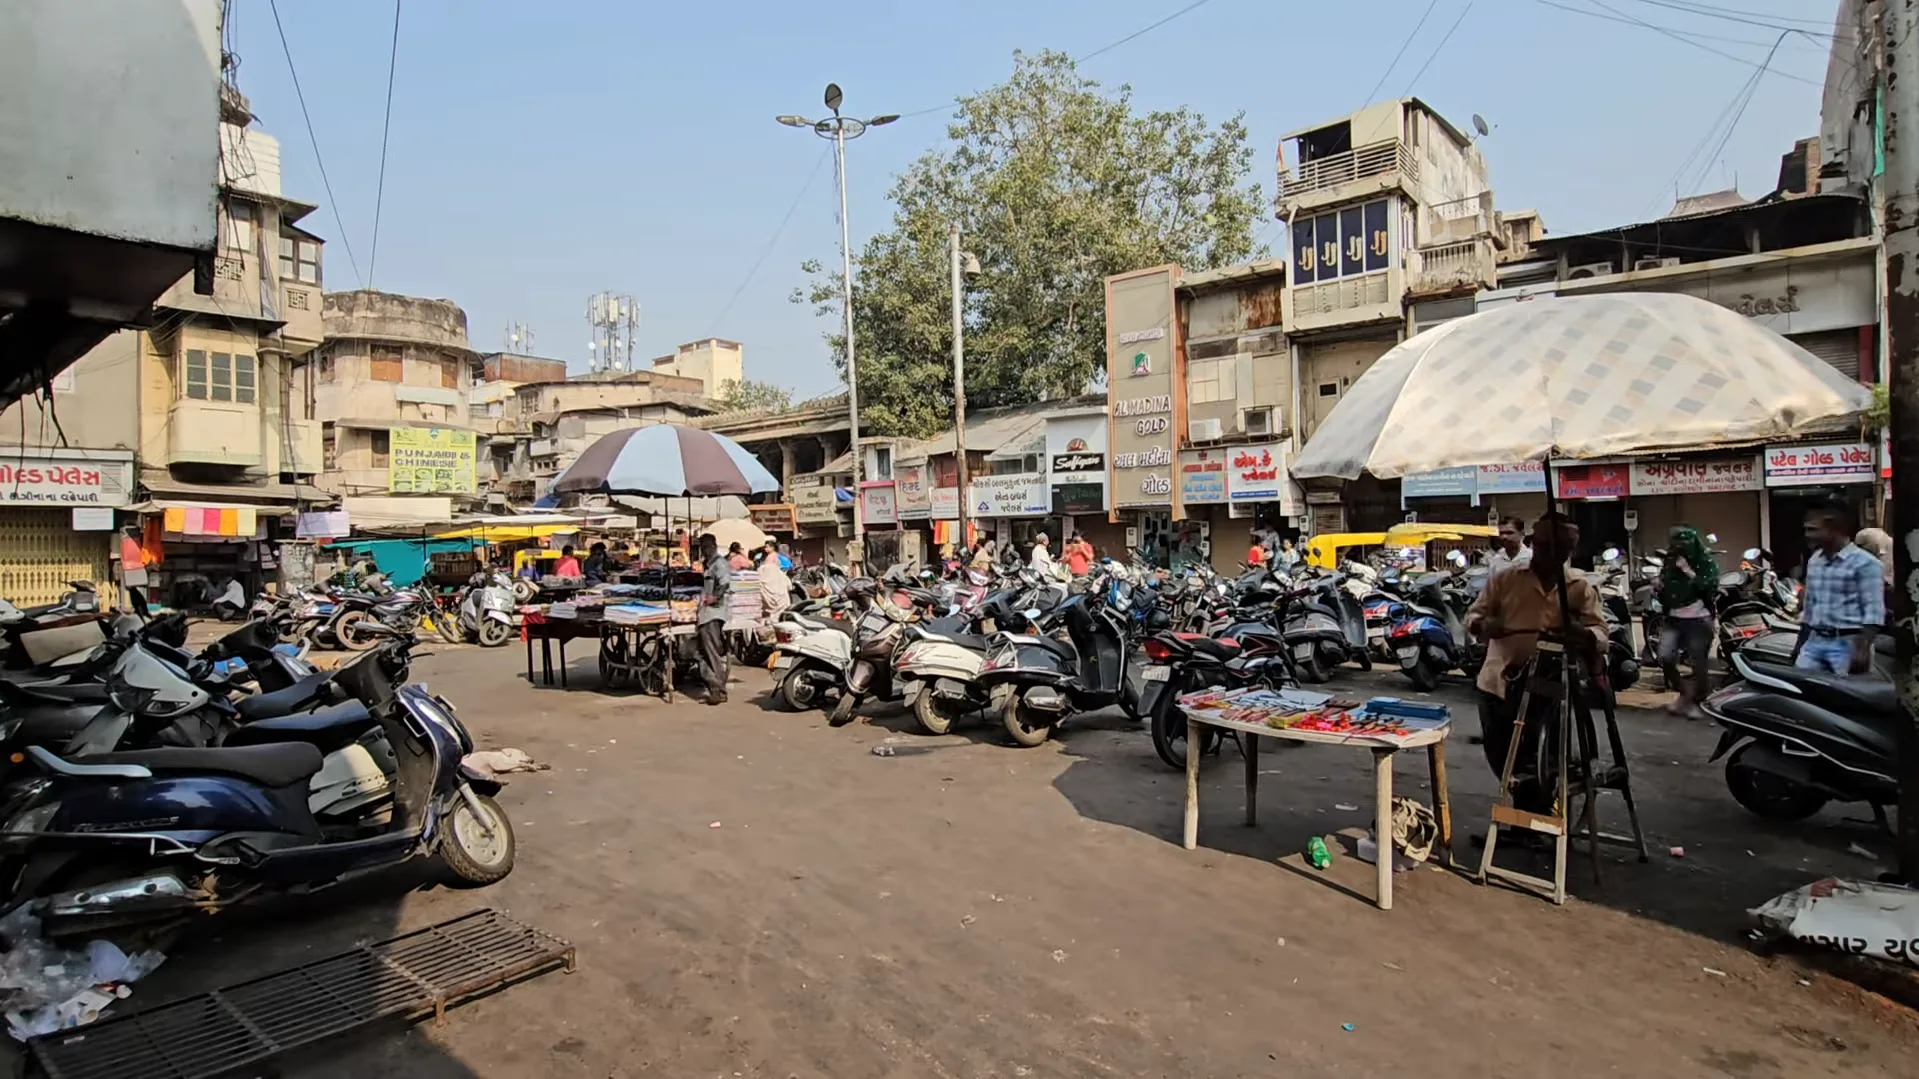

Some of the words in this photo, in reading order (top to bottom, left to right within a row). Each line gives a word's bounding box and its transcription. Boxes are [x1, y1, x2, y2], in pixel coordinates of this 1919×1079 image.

[1136, 417, 1167, 435] GOLD
[395, 449, 457, 459] PUNJABI
[395, 459, 457, 468] CHINESE
[1114, 452, 1134, 467] અલ
[1139, 446, 1171, 466] મદીના
[1770, 451, 1797, 467] પટેલ
[1803, 448, 1834, 465] ગોલ્ડ
[0, 465, 43, 483] ોલ્ડ
[46, 466, 99, 485] પેલેસ
[1142, 474, 1170, 494] ગોલ્ડ
